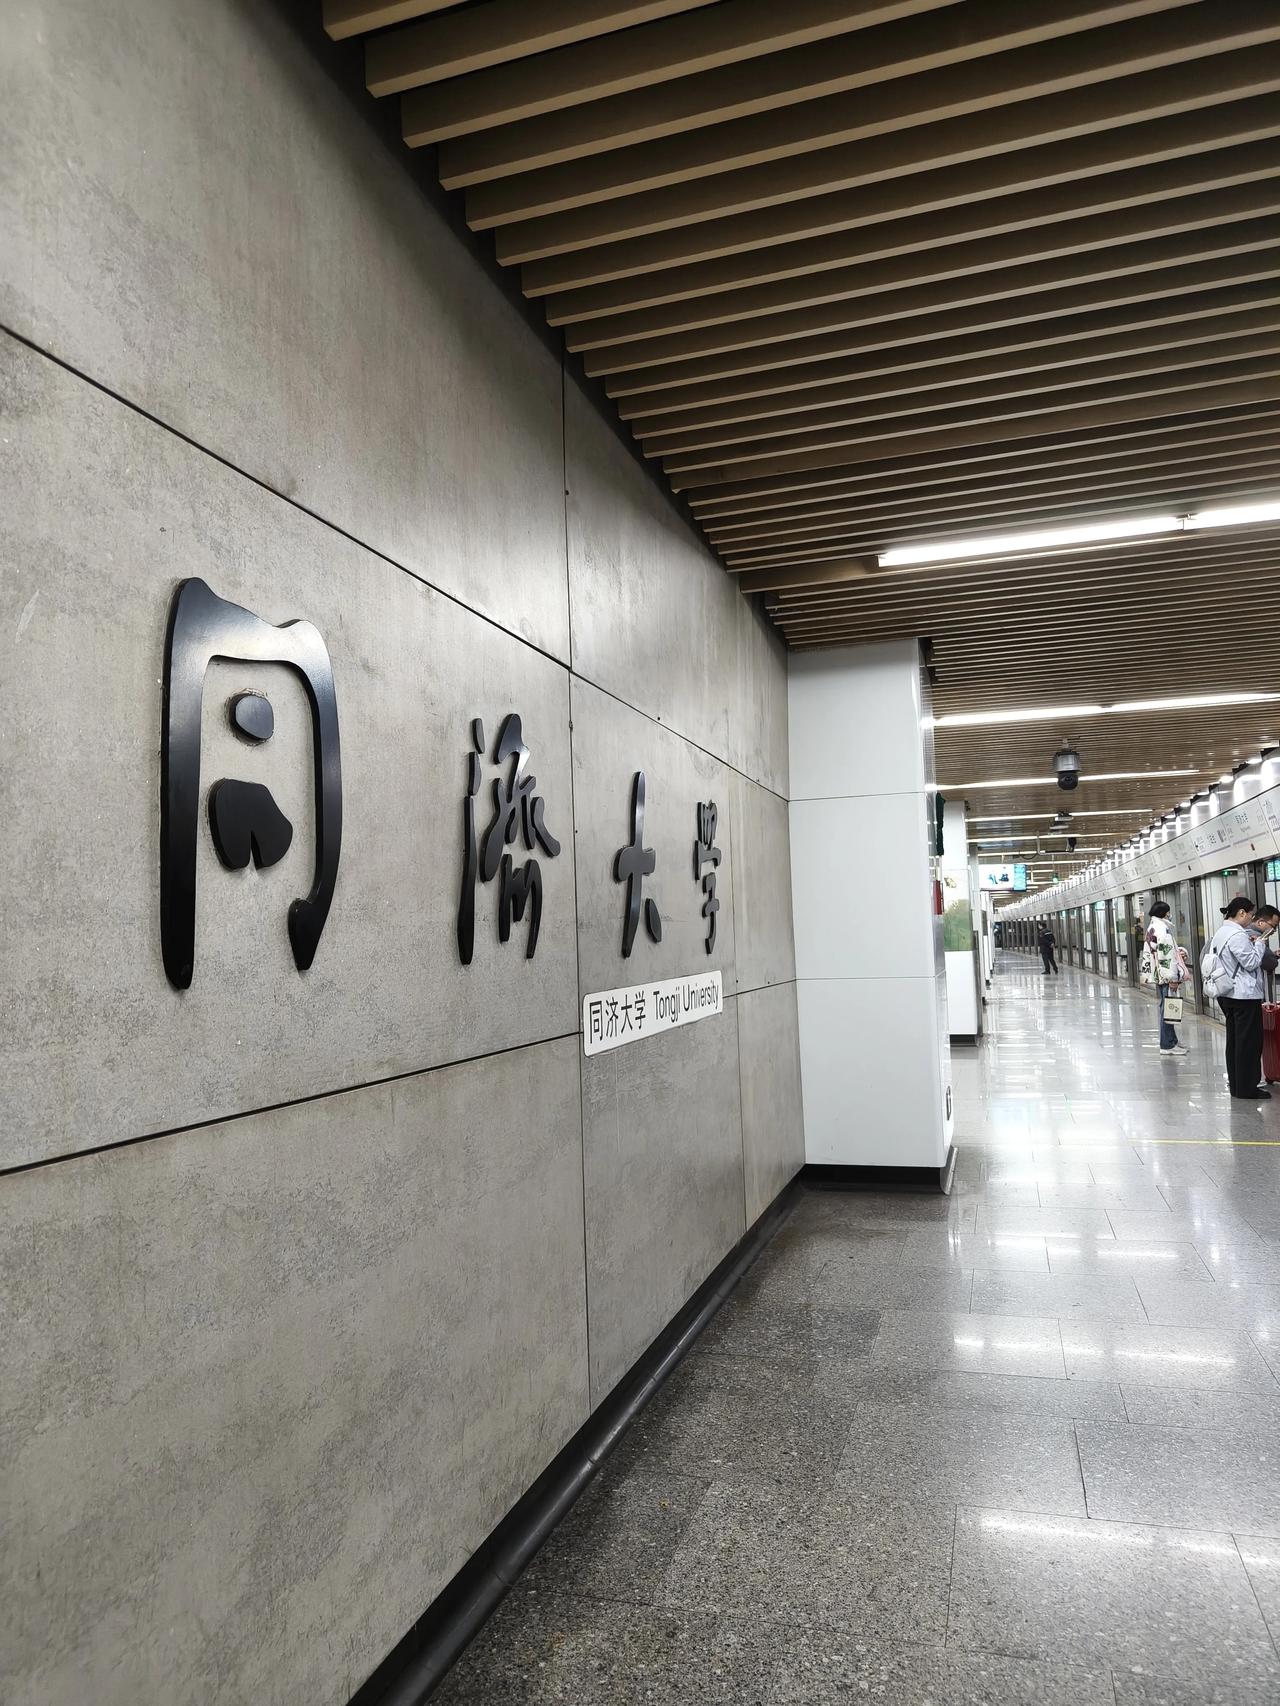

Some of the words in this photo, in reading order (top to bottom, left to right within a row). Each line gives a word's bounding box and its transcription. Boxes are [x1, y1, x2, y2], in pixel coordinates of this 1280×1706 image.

[589, 990, 646, 1044] 同济大学
[653, 986, 680, 1023] Tongji
[682, 979, 719, 1012] University
